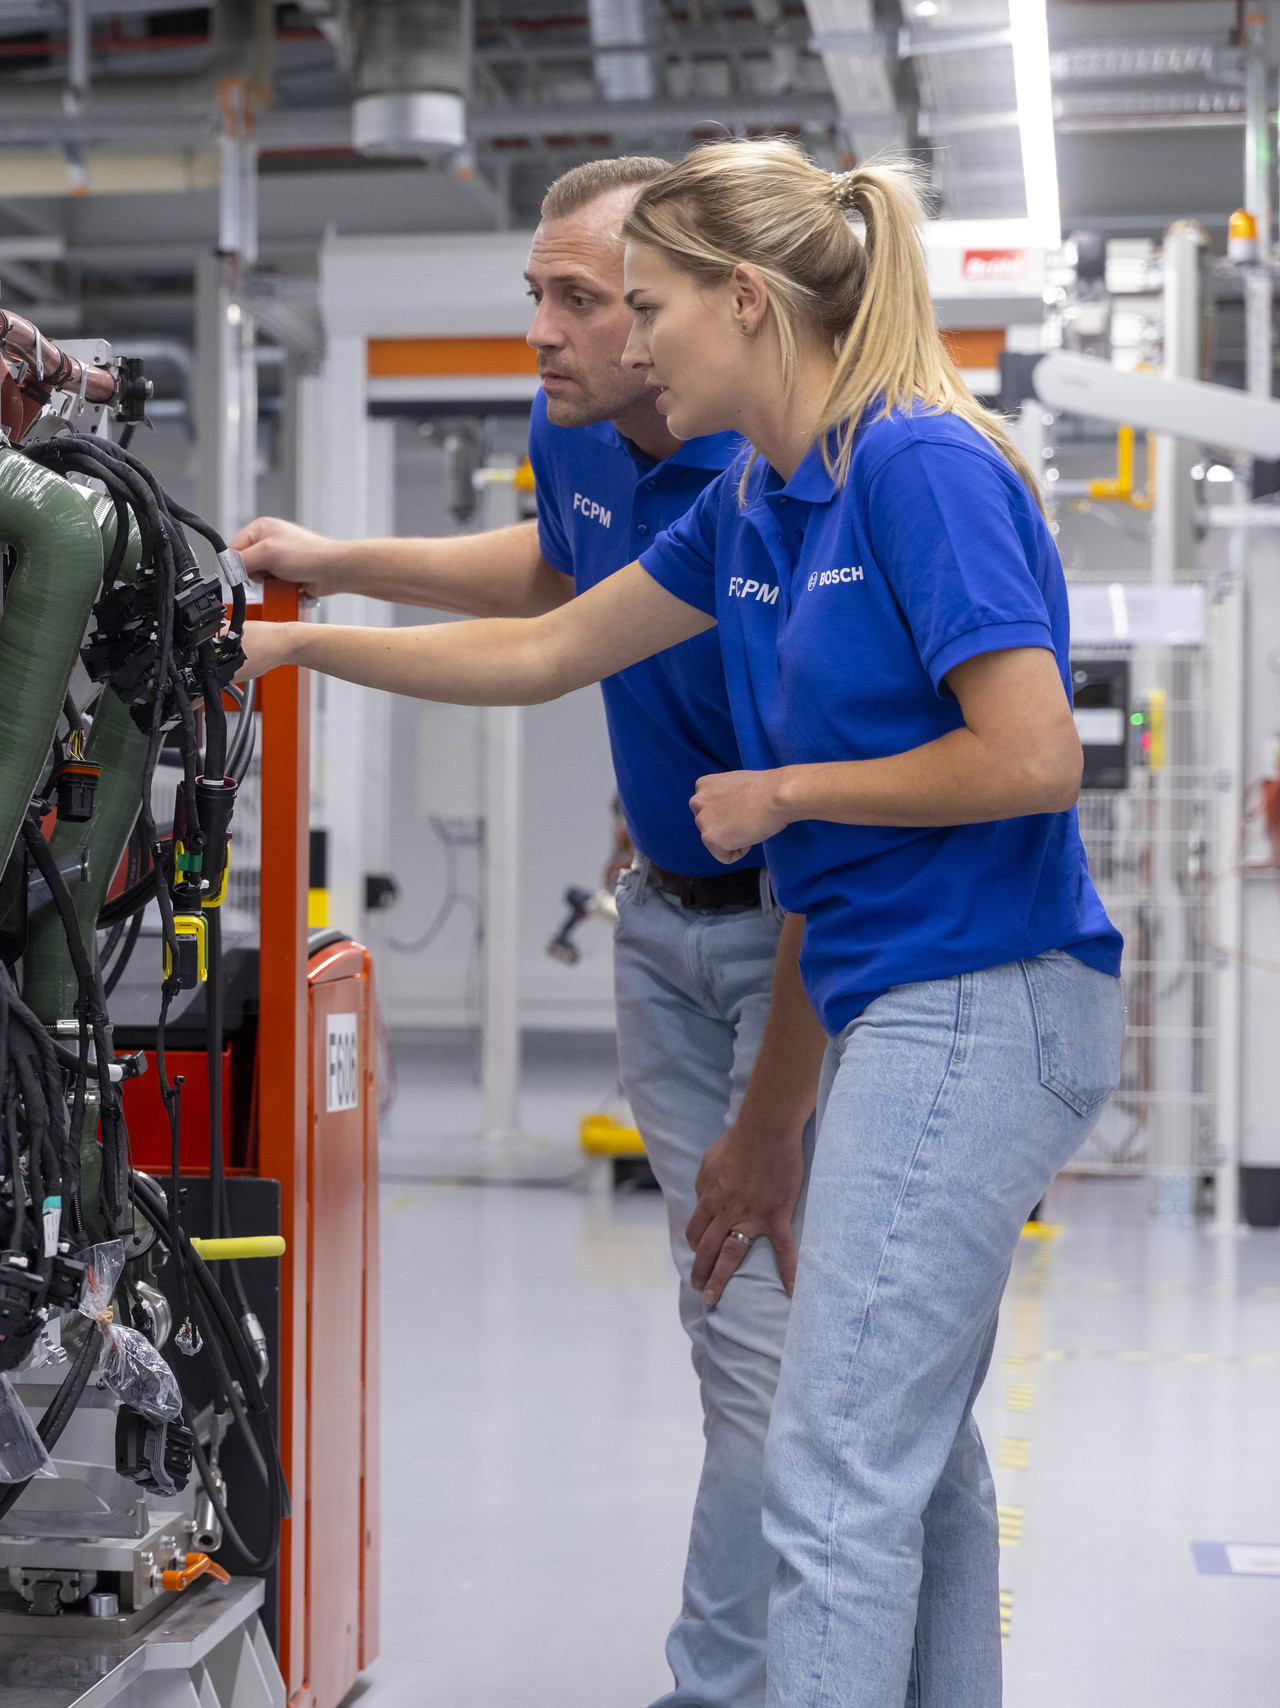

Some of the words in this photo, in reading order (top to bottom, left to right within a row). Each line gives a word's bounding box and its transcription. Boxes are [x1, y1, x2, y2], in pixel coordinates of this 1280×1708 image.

[573, 492, 611, 528] FCPM
[819, 566, 864, 586] BOSCH
[728, 577, 780, 604] FCPM
